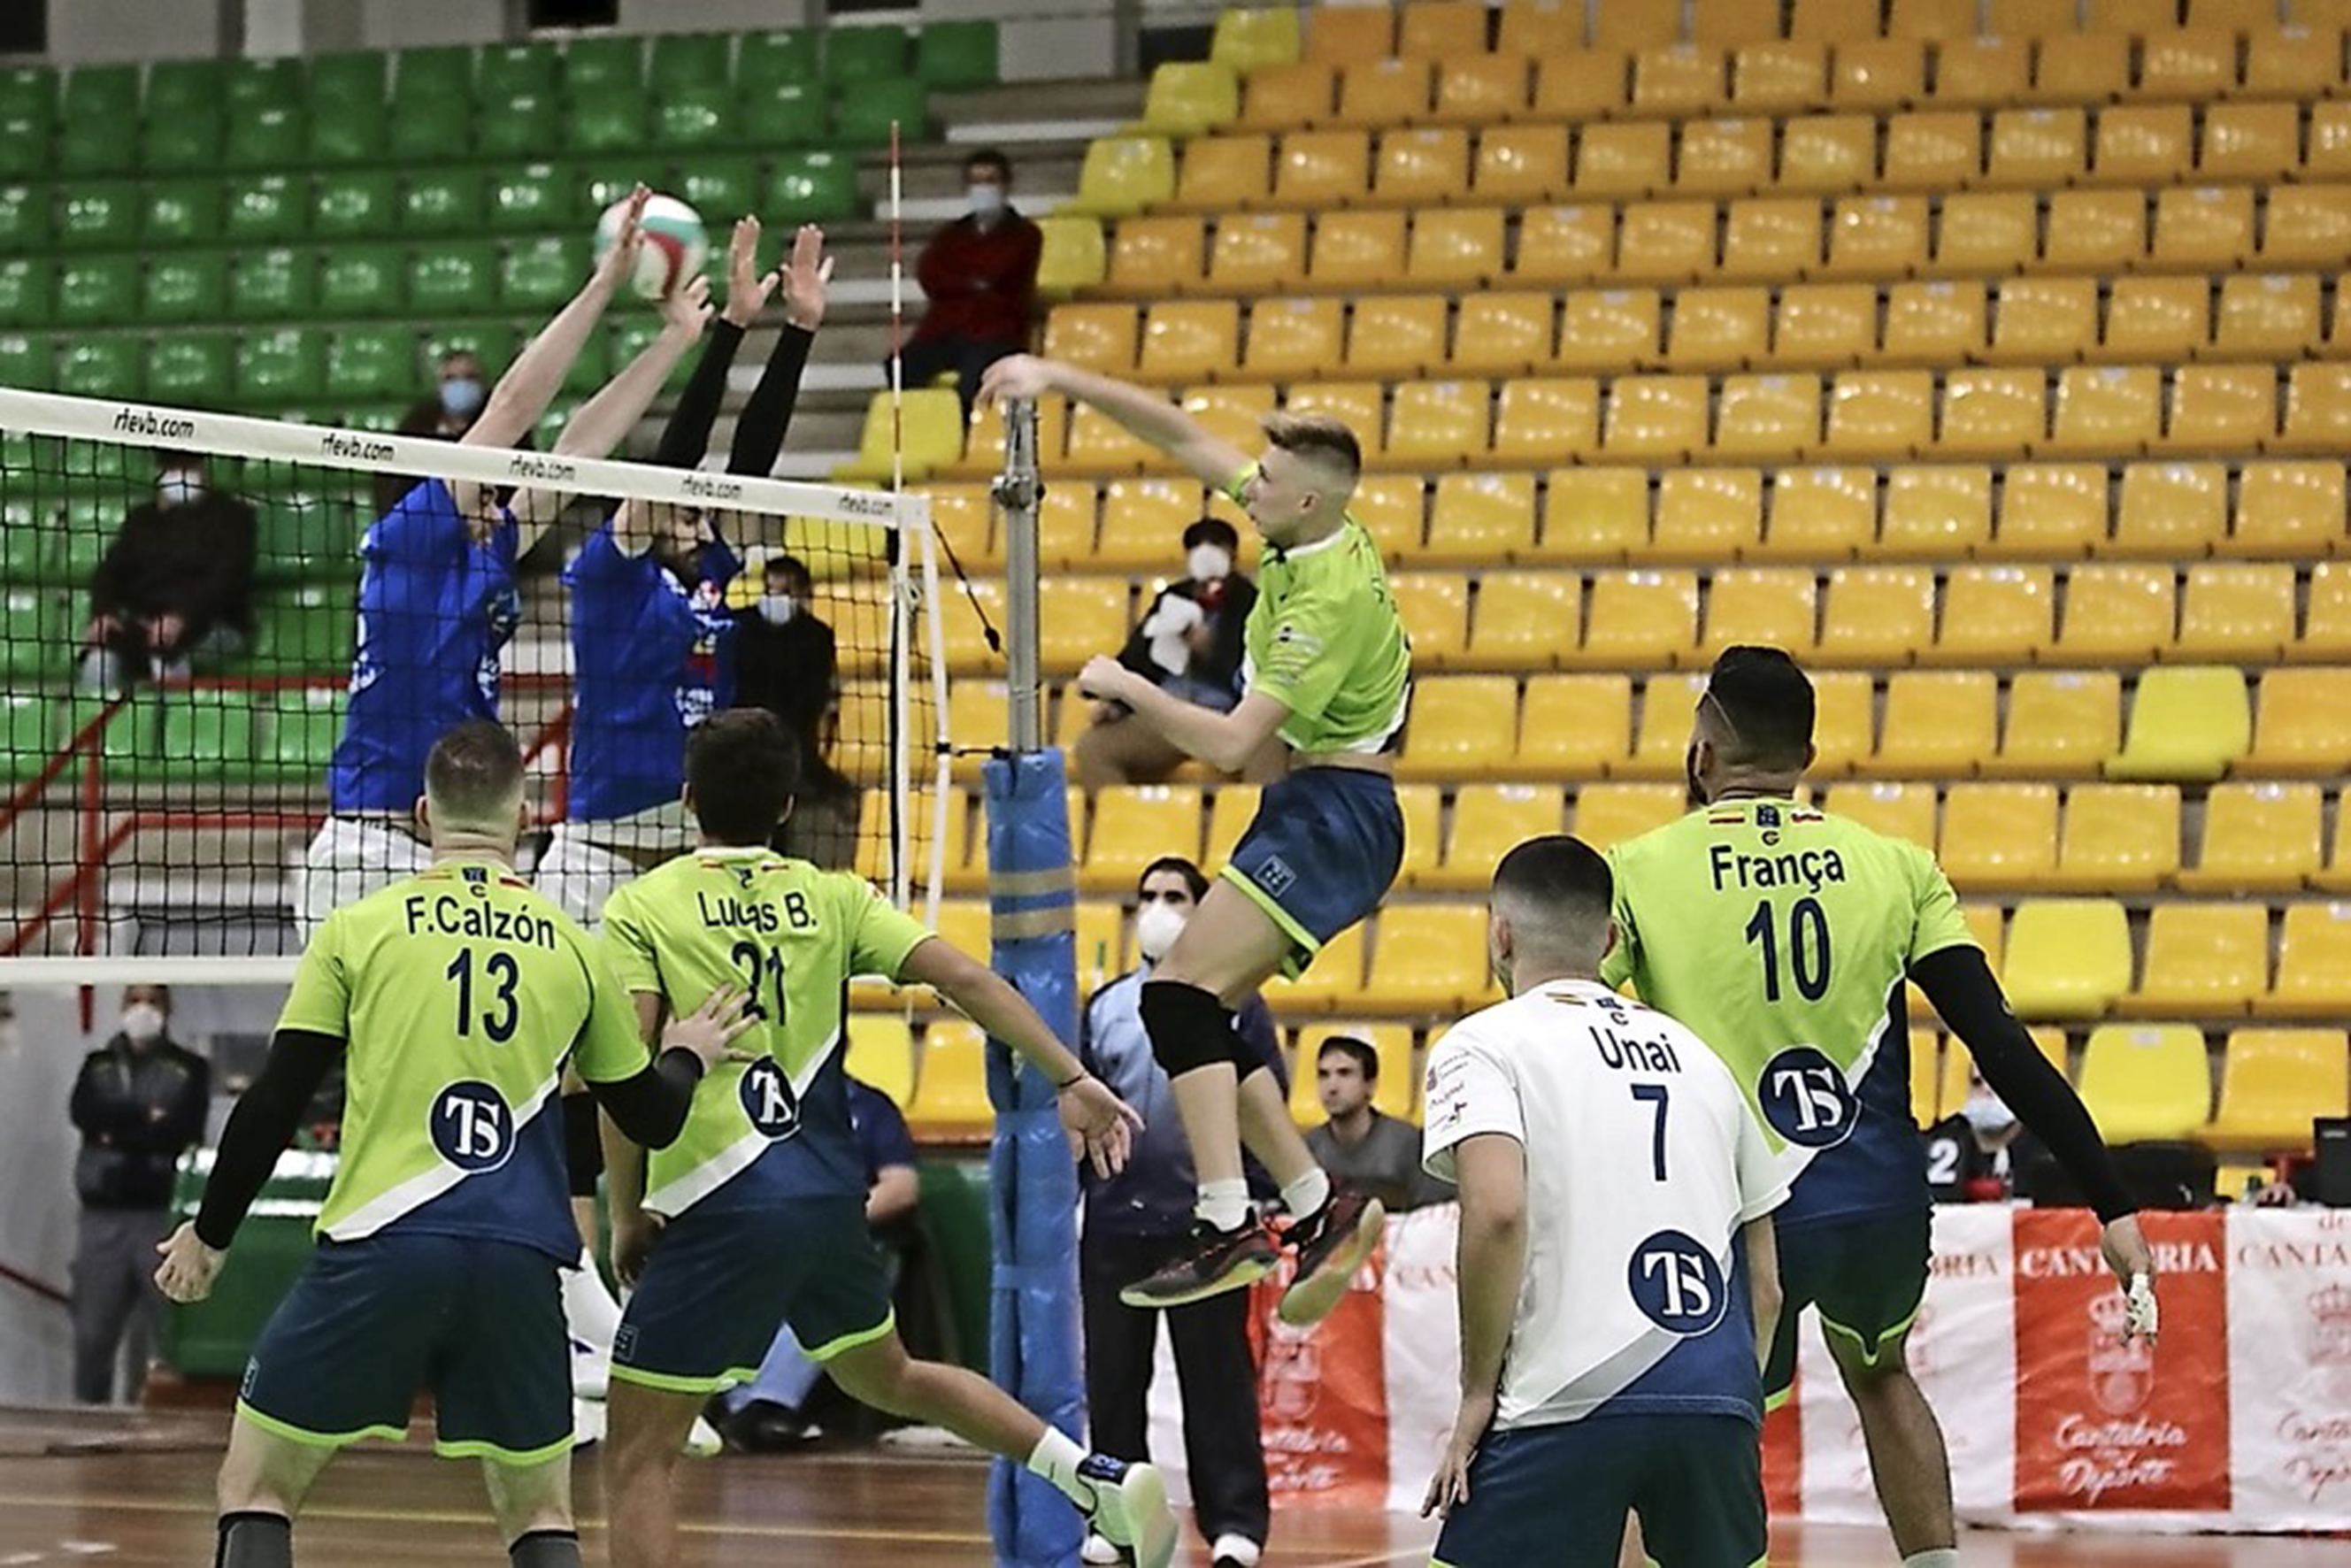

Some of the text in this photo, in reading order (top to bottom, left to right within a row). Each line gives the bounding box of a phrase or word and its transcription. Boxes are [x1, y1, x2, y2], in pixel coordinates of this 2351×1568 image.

[114, 408, 195, 438] rfevb.com
[321, 432, 396, 461] rfevb.com
[1709, 844, 1846, 894] França
[405, 895, 556, 950] F.Calzón
[697, 891, 818, 934] Lucas B.
[1746, 896, 1831, 1002] 10
[447, 947, 520, 1043] 13
[732, 941, 787, 1026] 21
[1589, 1025, 1682, 1074] Unai
[445, 1095, 502, 1158] TS
[1773, 1067, 1843, 1131] TS
[1630, 1082, 1670, 1182] 7
[1925, 1138, 1959, 1184] 2
[1643, 1250, 1711, 1316] TS
[2021, 1242, 2219, 1277] CANTRIA
